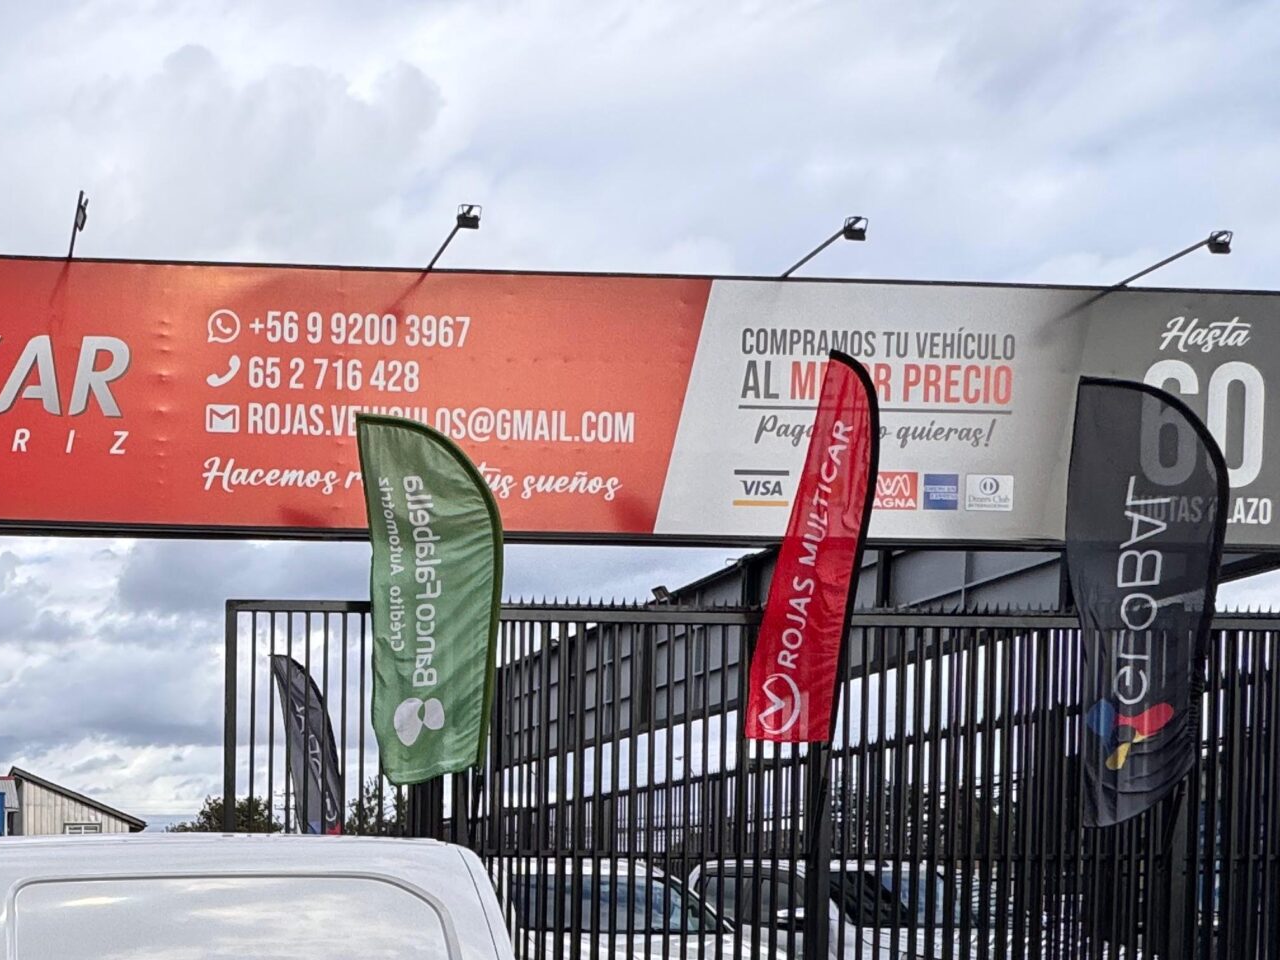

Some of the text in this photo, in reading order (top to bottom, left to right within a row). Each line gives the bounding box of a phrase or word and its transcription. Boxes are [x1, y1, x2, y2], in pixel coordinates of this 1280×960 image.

[249, 310, 471, 348] +56 9 9200 3967
[741, 327, 1016, 361] COMPRAMOS TU VEHÍCULO
[1159, 316, 1251, 352] Hasta
[248, 356, 420, 393] 65 2 716 428
[741, 360, 779, 400] AL
[903, 364, 1013, 405] PRECIO
[896, 418, 997, 449] quieras!
[1140, 359, 1265, 488] 60
[202, 456, 341, 495] Hacemos
[520, 470, 623, 501] sueños
[740, 480, 783, 496] VISA
[872, 498, 916, 508] AGNA
[777, 420, 854, 669] ROJAS MULTICAR
